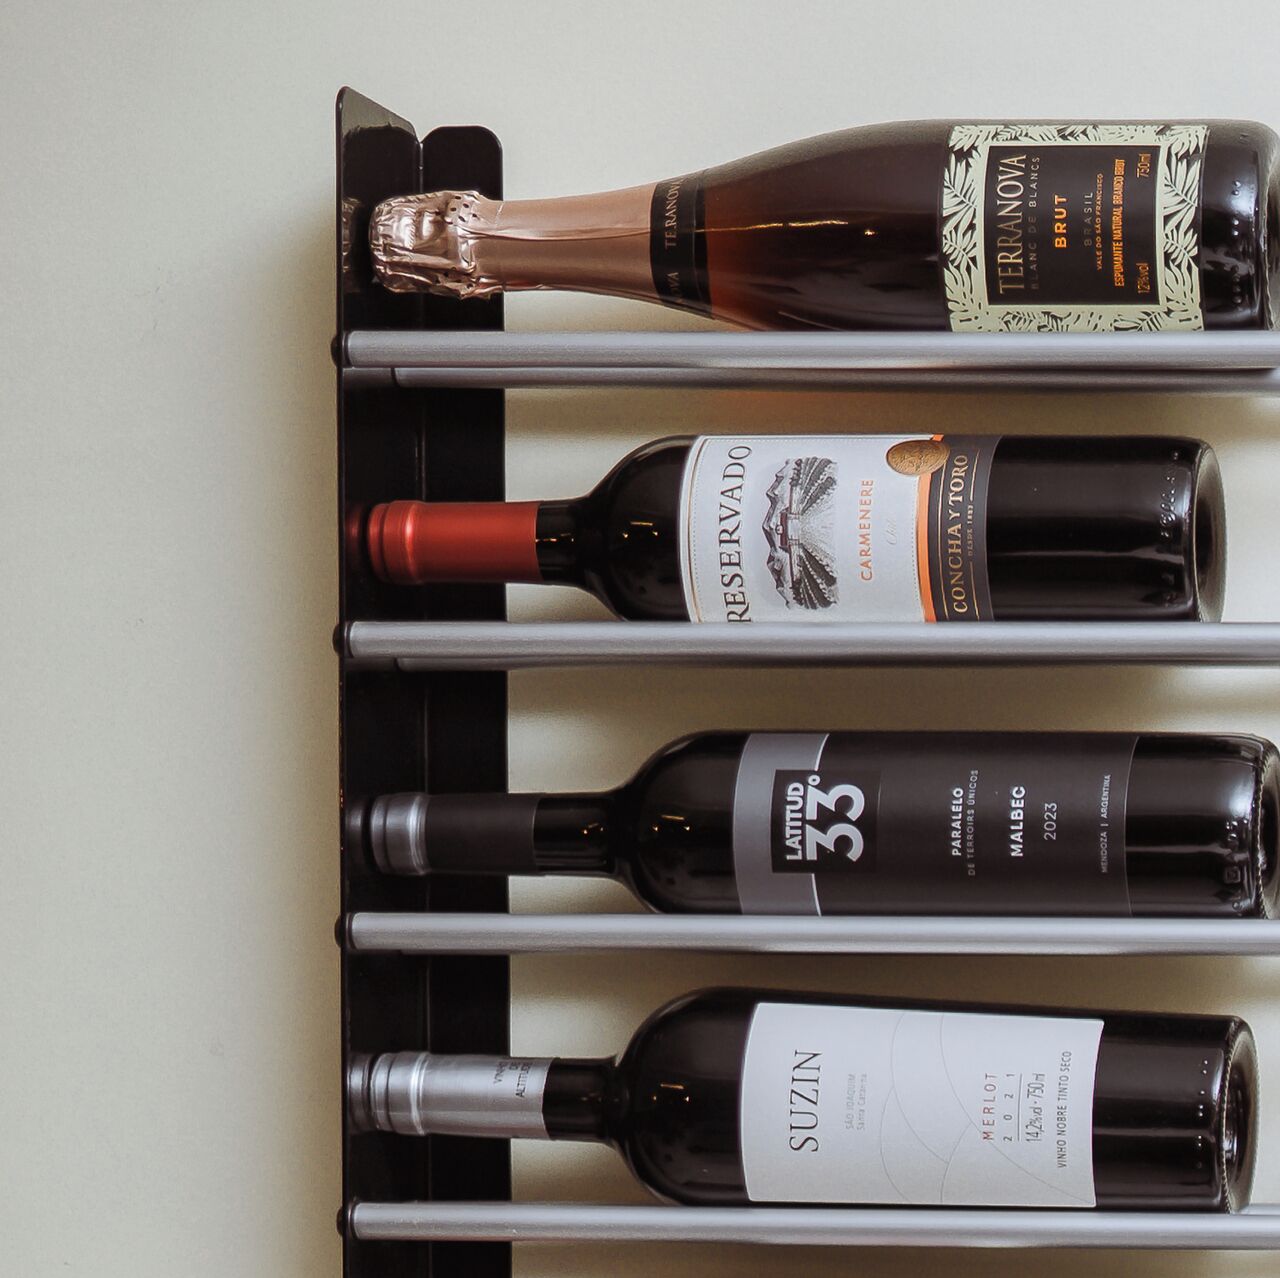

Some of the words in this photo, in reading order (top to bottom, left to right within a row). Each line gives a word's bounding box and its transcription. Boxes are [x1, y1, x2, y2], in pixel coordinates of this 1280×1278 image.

[1028, 155, 1040, 208] BLANCS
[1114, 157, 1126, 176] BRUT
[1096, 172, 1104, 216] FRANCISCO
[1112, 175, 1126, 206] BRANCO
[996, 153, 1027, 294] TERRANOVA
[1028, 213, 1038, 234] DE
[1054, 193, 1068, 248] BRUT
[1083, 191, 1094, 246] BRASIL
[1112, 205, 1124, 240] NATURAL
[1096, 235, 1102, 248] DO
[1112, 241, 1126, 286] ESPUMANTE
[1028, 241, 1040, 290] BLANC
[947, 453, 969, 505] TORO
[718, 445, 752, 622] RESERVADO
[858, 479, 874, 581] CARMENERE
[948, 507, 962, 520] Y
[946, 525, 968, 612] CONCHA
[966, 768, 979, 806] ÚNICOS
[1100, 773, 1112, 819] ARGENTINA
[785, 781, 804, 860] LATITUD
[950, 787, 964, 856] PARALELO
[966, 807, 976, 858] TERROIRS
[1010, 785, 1026, 858] MALBEC
[1042, 801, 1058, 842] 2023
[966, 863, 976, 876] DE
[1100, 829, 1109, 873] MENDOZA
[1058, 1051, 1072, 1073] SECO
[788, 1047, 823, 1154] SUZIN
[846, 1073, 856, 1112] JOAQUIM
[982, 1072, 998, 1142] MERLOT
[1058, 1075, 1070, 1102] TINTO
[844, 1112, 856, 1130] SÃO
[856, 1107, 866, 1132] Santa
[1056, 1105, 1068, 1137] NOBRE
[1056, 1139, 1068, 1169] VINHO
